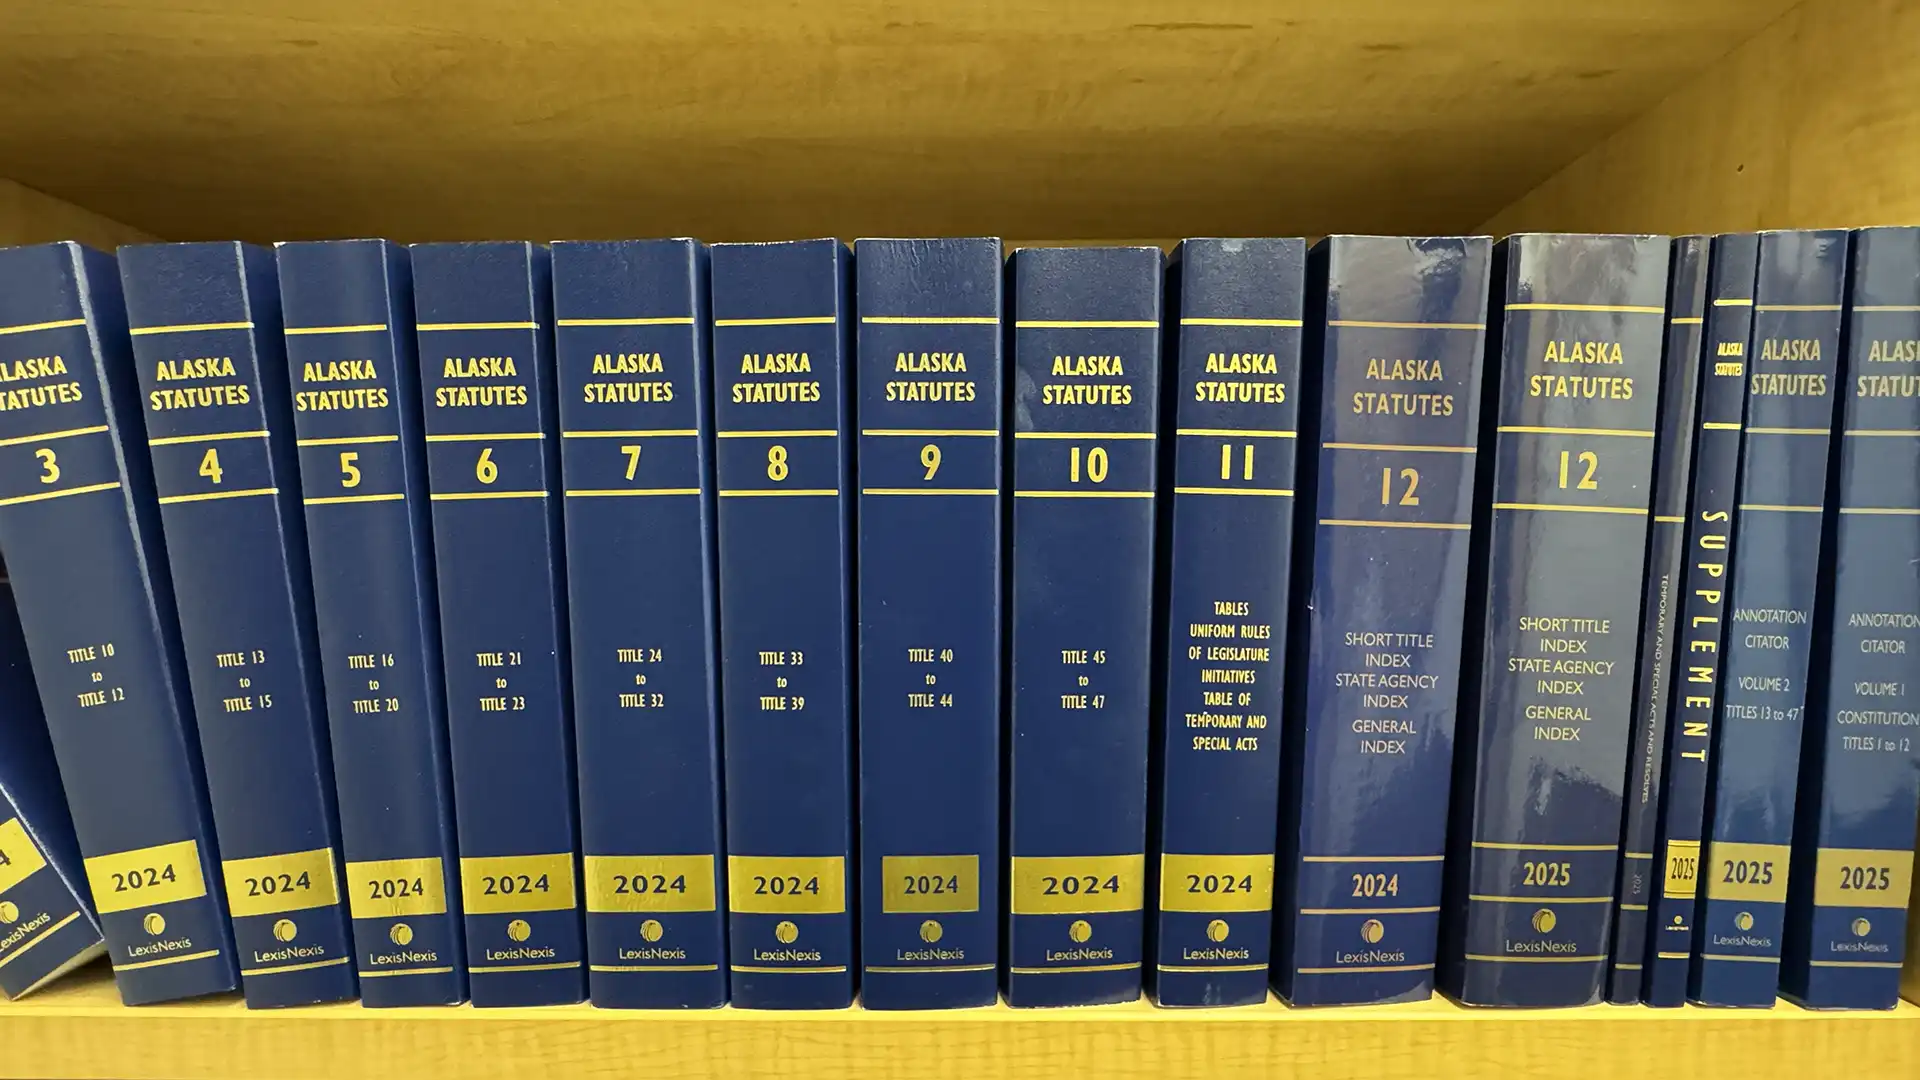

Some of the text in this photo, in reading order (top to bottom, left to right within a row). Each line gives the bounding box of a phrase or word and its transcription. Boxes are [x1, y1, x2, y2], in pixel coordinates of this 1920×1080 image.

[1543, 340, 1624, 365] ALASKA
[1761, 339, 1821, 361] ALASKA
[156, 357, 236, 381] ALASKA
[304, 360, 377, 383] ALASKA
[443, 357, 517, 378] ALASKA
[592, 353, 664, 374] ALASKA
[741, 353, 811, 374] ALASKA
[895, 352, 967, 373] ALASKA
[1051, 355, 1124, 376] ALASKA
[1205, 353, 1278, 374] ALASKA
[1366, 358, 1444, 382] ALASKA
[584, 382, 673, 403] STATUTES
[732, 381, 821, 403] STATUTES
[886, 381, 976, 402] STATUTES
[1195, 382, 1285, 404] STATUTES
[1530, 375, 1633, 400] STATUTES
[1751, 374, 1827, 396] STATUTES
[150, 385, 250, 411] STATUTES
[296, 388, 389, 412] STATUTES
[435, 385, 528, 407] STATUTES
[1042, 384, 1132, 405] STATUTES
[1353, 392, 1454, 416] STATUTES
[34, 449, 61, 484] 3
[198, 449, 223, 484] 4
[339, 452, 361, 488] 5
[475, 448, 498, 484] 6
[621, 445, 642, 481] 7
[767, 445, 789, 482] 8
[920, 444, 942, 481] 9
[1070, 447, 1109, 484] 10
[1220, 444, 1255, 481] 11
[1559, 451, 1598, 490] 12
[1381, 467, 1420, 506] 12
[1214, 601, 1249, 617] TABLES
[1658, 574, 1669, 635] TEMPORARY
[1733, 608, 1807, 624] ANNOTATION
[1848, 613, 1920, 628] ANNOTATION
[1189, 623, 1271, 639] UNIFORM RULES
[1519, 617, 1610, 634] SHORT TITLE
[1345, 631, 1434, 648] SHORT TITLE
[1540, 638, 1587, 653] INDEX
[1681, 511, 1728, 762] SUPPLEMENT
[1745, 635, 1789, 649] CITATOR
[67, 643, 115, 663] TITLE 10
[617, 649, 662, 662] TITLE 24
[908, 649, 953, 662] TITLE 40
[1188, 646, 1270, 662] OF LEGISLATURE
[1655, 636, 1663, 660] AND
[1860, 640, 1906, 654] CITATOR
[216, 649, 266, 668] TITLE 13
[348, 653, 394, 669] TITLE 16
[476, 652, 521, 666] TITLE 21
[759, 652, 804, 665] TITLE 33
[1061, 651, 1106, 664] TITLE 45
[1365, 653, 1411, 668] INDEX
[91, 670, 103, 682] to
[1508, 658, 1615, 676] STATE AGENCY
[239, 677, 251, 688] to
[369, 679, 379, 690] to
[496, 678, 507, 689] to
[636, 674, 646, 685] to
[777, 677, 787, 688] to
[926, 674, 936, 685] to
[1078, 675, 1089, 686] to
[1201, 668, 1256, 685] INITIATIVES
[1335, 673, 1439, 690] STATE AGENCY
[1651, 662, 1661, 701] SPECIAL
[1739, 677, 1790, 691] VOLUME 2
[1537, 680, 1584, 696] INDEX
[1854, 682, 1904, 696] VOLUME 1
[77, 688, 125, 708] TITLE 12
[223, 695, 272, 712] TITLE 15
[353, 698, 399, 714] TITLE 20
[479, 697, 525, 711] TITLE 23
[619, 694, 664, 708] TITLE 32
[760, 697, 805, 710] TITLE 39
[908, 694, 953, 707] TITLE 44
[1061, 695, 1105, 709] TITLE 47
[1203, 691, 1252, 707] TABLE OF
[1363, 694, 1409, 709] INDEX
[1185, 712, 1267, 729] TEMPORARY AND
[1525, 705, 1591, 721] GENERAL
[1648, 702, 1656, 729] ACTS
[1726, 705, 1799, 720] TITLES 13 to 47
[1837, 710, 1920, 726] CONSTITUTION
[1352, 719, 1416, 735] GENERAL
[1534, 726, 1580, 741] INDEX
[1192, 736, 1258, 751] SPECIAL ACTS
[1360, 739, 1406, 755] INDEX
[1646, 730, 1654, 754] AND
[1842, 736, 1874, 750] TITLES
[1878, 738, 1882, 751] 1
[1900, 737, 1910, 752] 12
[111, 863, 177, 893] 2024
[1523, 862, 1571, 886] 2025
[1671, 858, 1694, 880] 2025
[1723, 860, 1773, 884] 2025
[245, 871, 312, 897] 2024
[482, 874, 550, 895] 2024
[612, 874, 687, 895] 2024
[753, 876, 820, 896] 2024
[903, 875, 959, 894] 2024
[1042, 875, 1120, 895] 2024
[1186, 874, 1253, 894] 2024
[1352, 873, 1399, 897] 2024
[1840, 867, 1890, 890] 2025
[368, 878, 424, 899] 2024
[127, 937, 192, 958] LexisNexis
[254, 944, 325, 963] LexisNexis
[486, 946, 555, 961] LexisNexis
[619, 946, 686, 961] LexisNexis
[753, 947, 821, 962] LexisNexis
[896, 947, 965, 961] LexisNexis
[1046, 947, 1113, 961] LexisNexis
[1183, 947, 1249, 961] LexisNexis
[1506, 940, 1577, 953] LexisNexis
[370, 950, 438, 965] LexisNexis
[1336, 949, 1404, 964] LexisNexis
